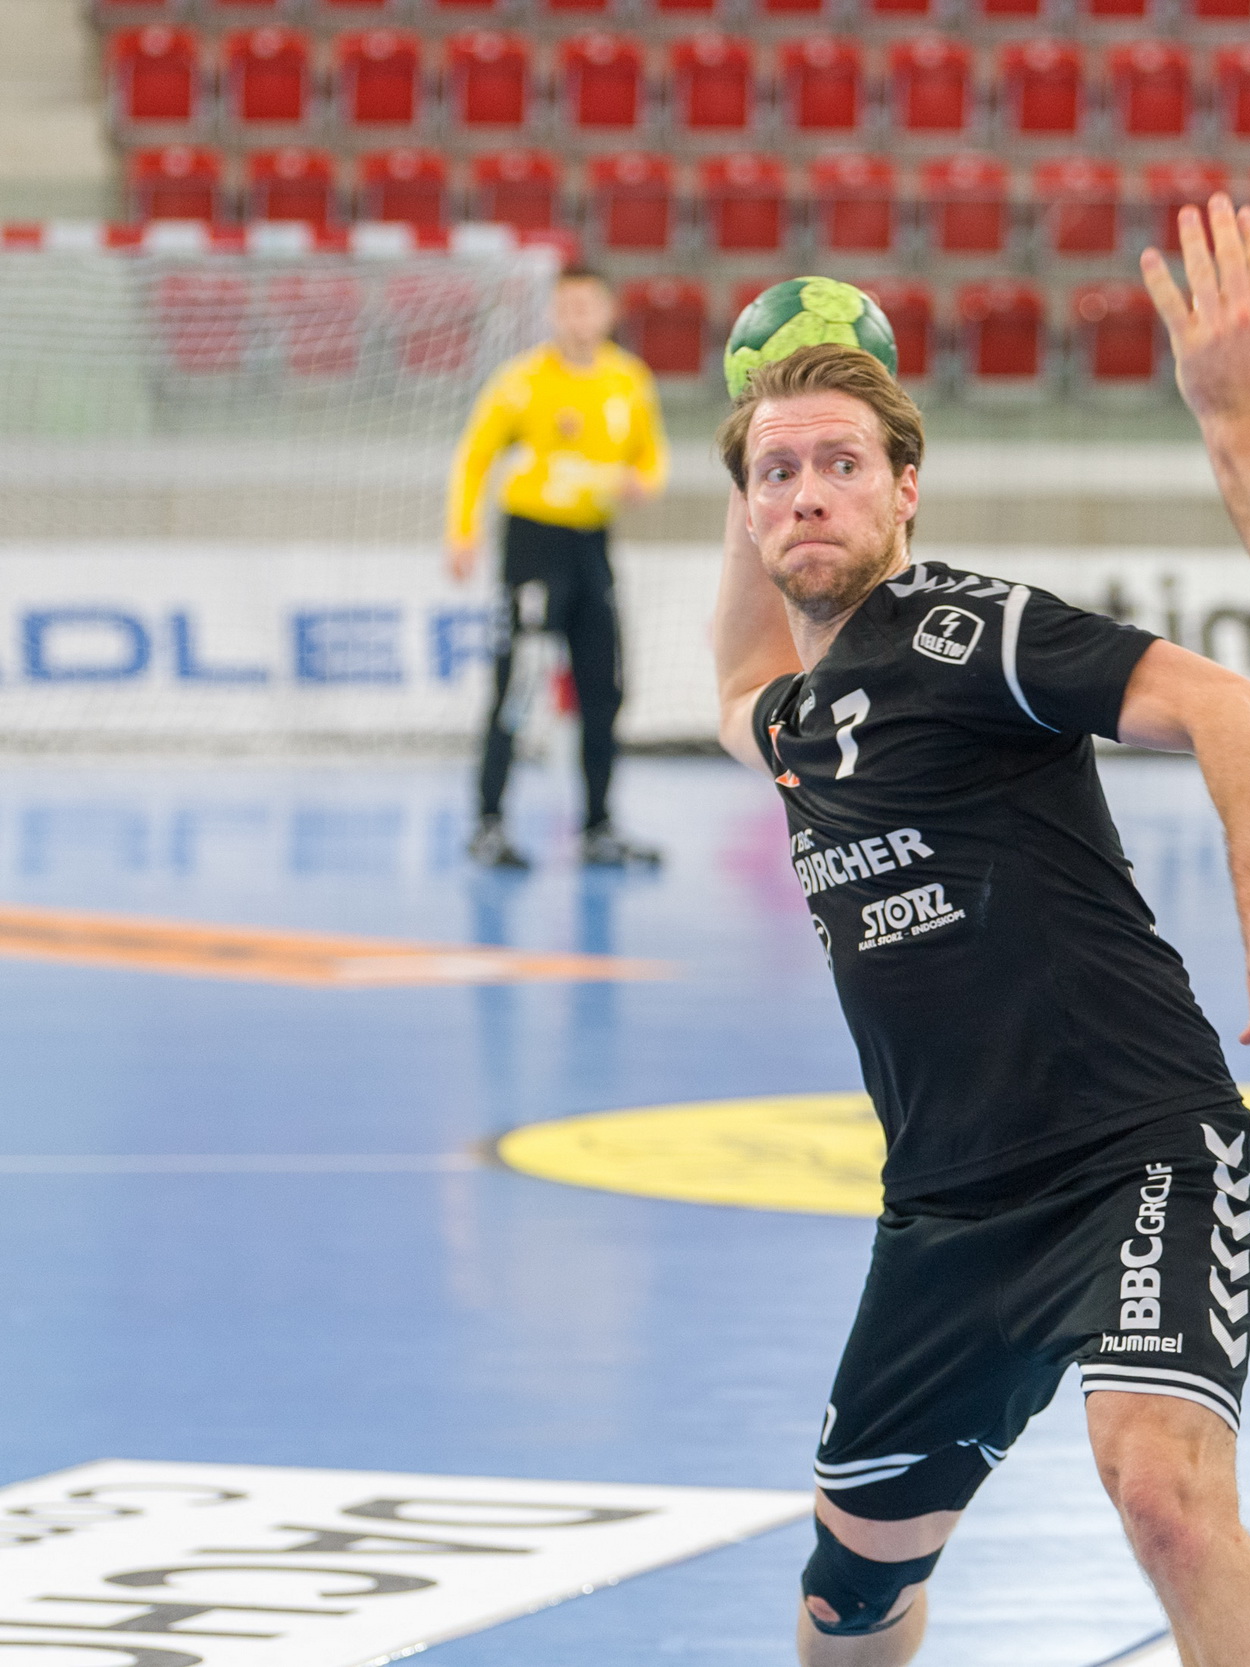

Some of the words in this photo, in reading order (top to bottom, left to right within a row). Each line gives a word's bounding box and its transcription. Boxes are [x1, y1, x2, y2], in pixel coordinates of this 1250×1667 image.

[830, 688, 871, 780] 7
[795, 827, 935, 898] BIRCHER
[858, 938, 878, 952] KARL
[877, 931, 904, 946] STORZ
[911, 908, 966, 936] ENDOSKOPE
[861, 882, 953, 939] STORZ
[1100, 1332, 1183, 1354] hummel
